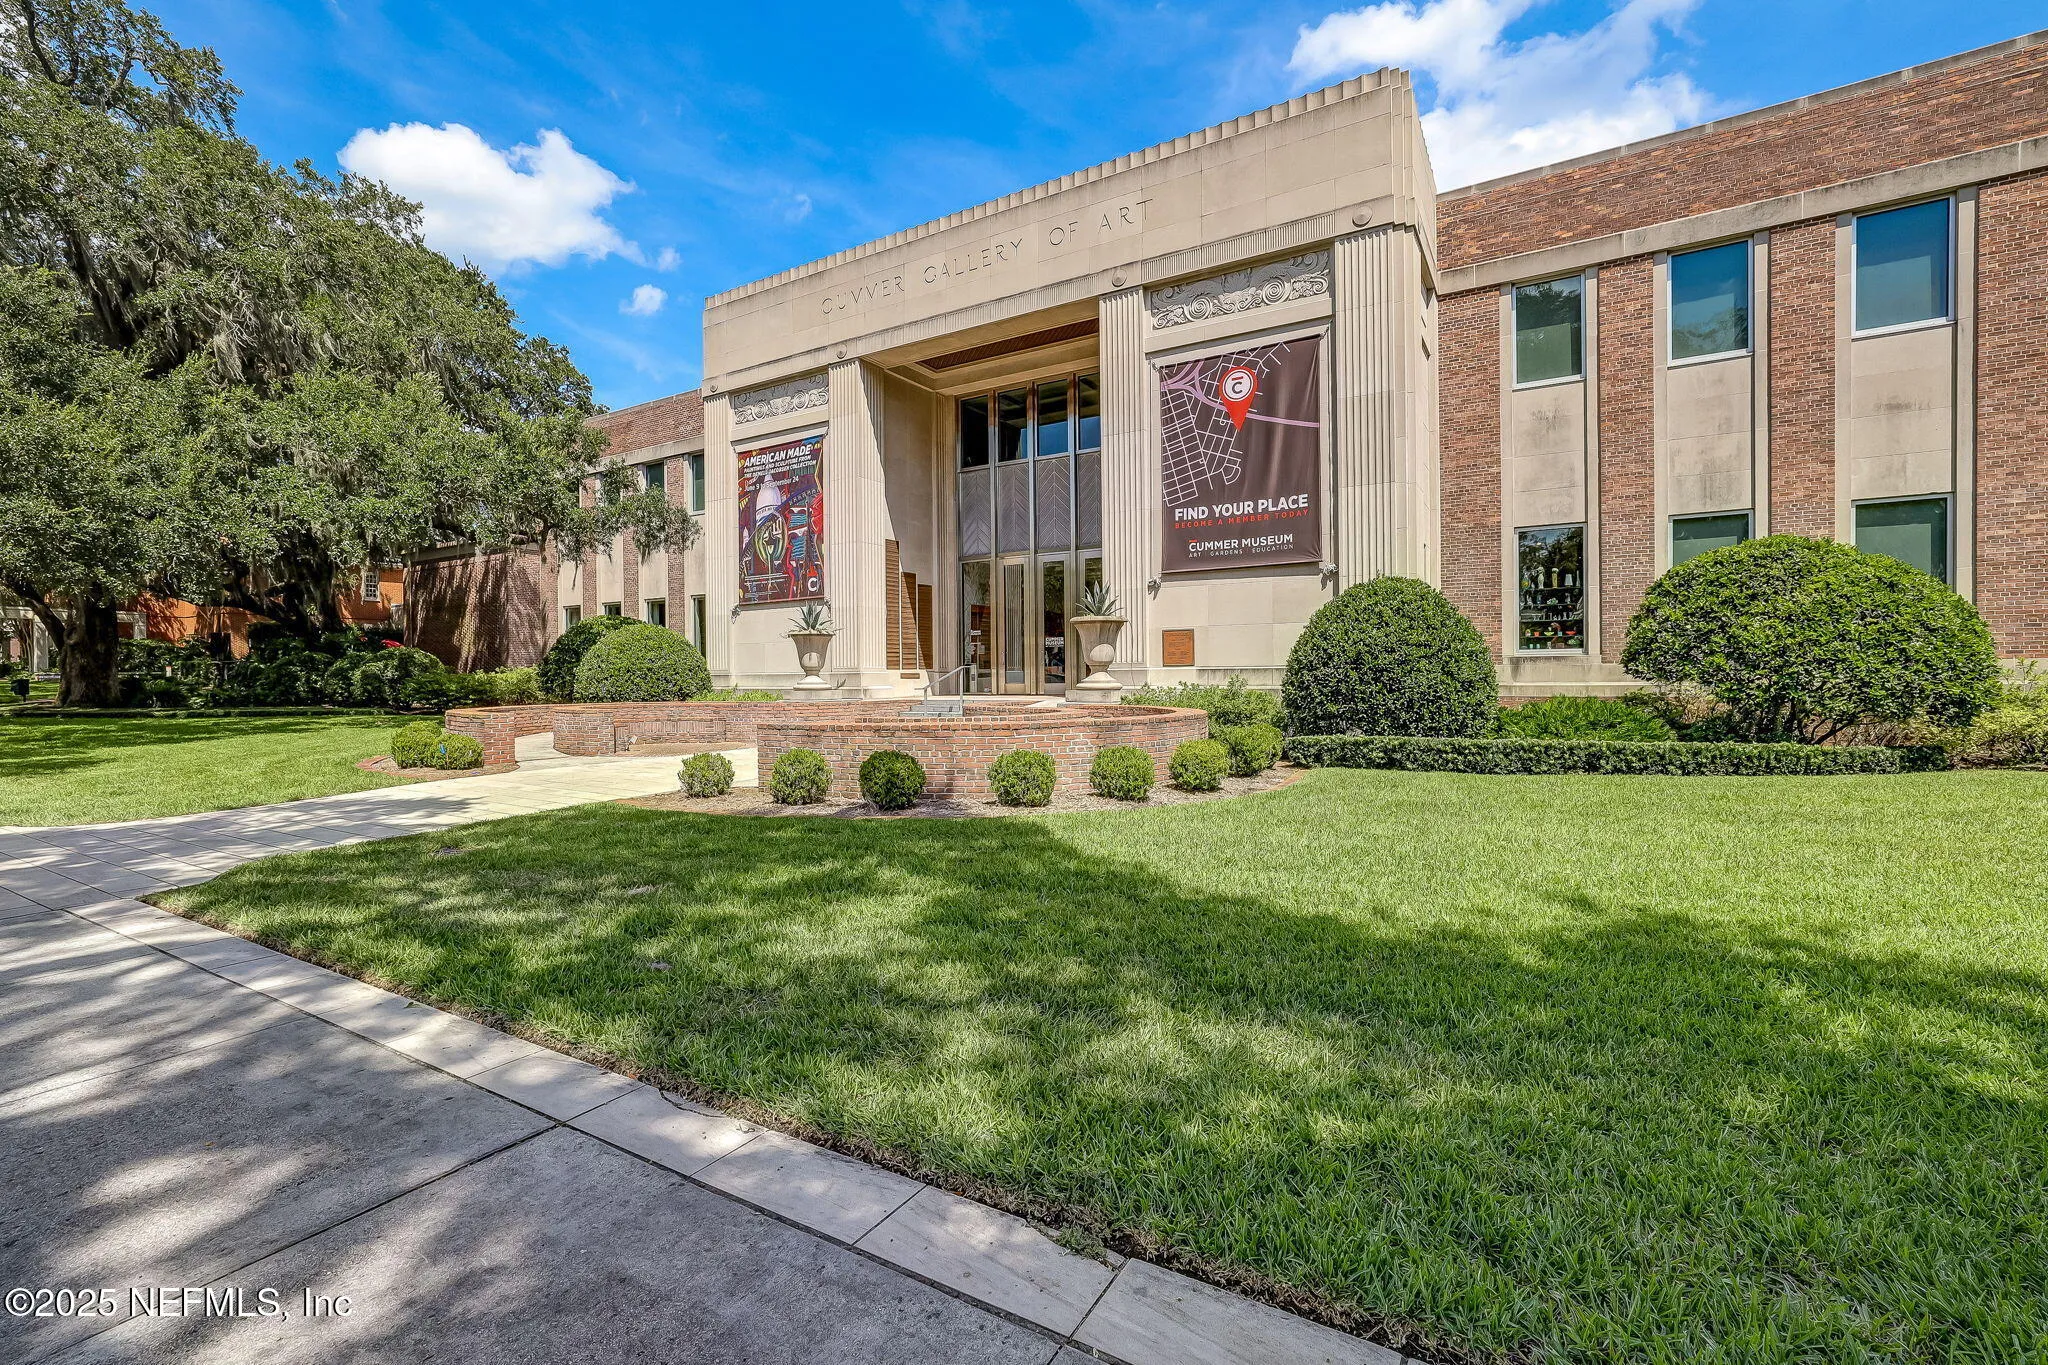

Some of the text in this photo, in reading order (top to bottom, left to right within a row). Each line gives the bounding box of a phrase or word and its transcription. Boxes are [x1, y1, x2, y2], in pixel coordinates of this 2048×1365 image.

[923, 238, 1022, 284] GALLERY
[1049, 221, 1078, 246] OF
[1098, 198, 1153, 235] ART
[744, 444, 812, 468] AMERICAN MADE
[790, 460, 817, 470] COLLECTION
[798, 454, 812, 462] FROM
[1175, 494, 1308, 521] FIND YOUR PLACE
[1175, 520, 1213, 529] BECOME
[1228, 513, 1270, 524] MEMBER
[1274, 509, 1309, 519] TODAY
[1189, 534, 1293, 552] CUMMER MUSEUM
[1210, 549, 1243, 557] GARDENS
[1252, 544, 1294, 554] EDUCATION
